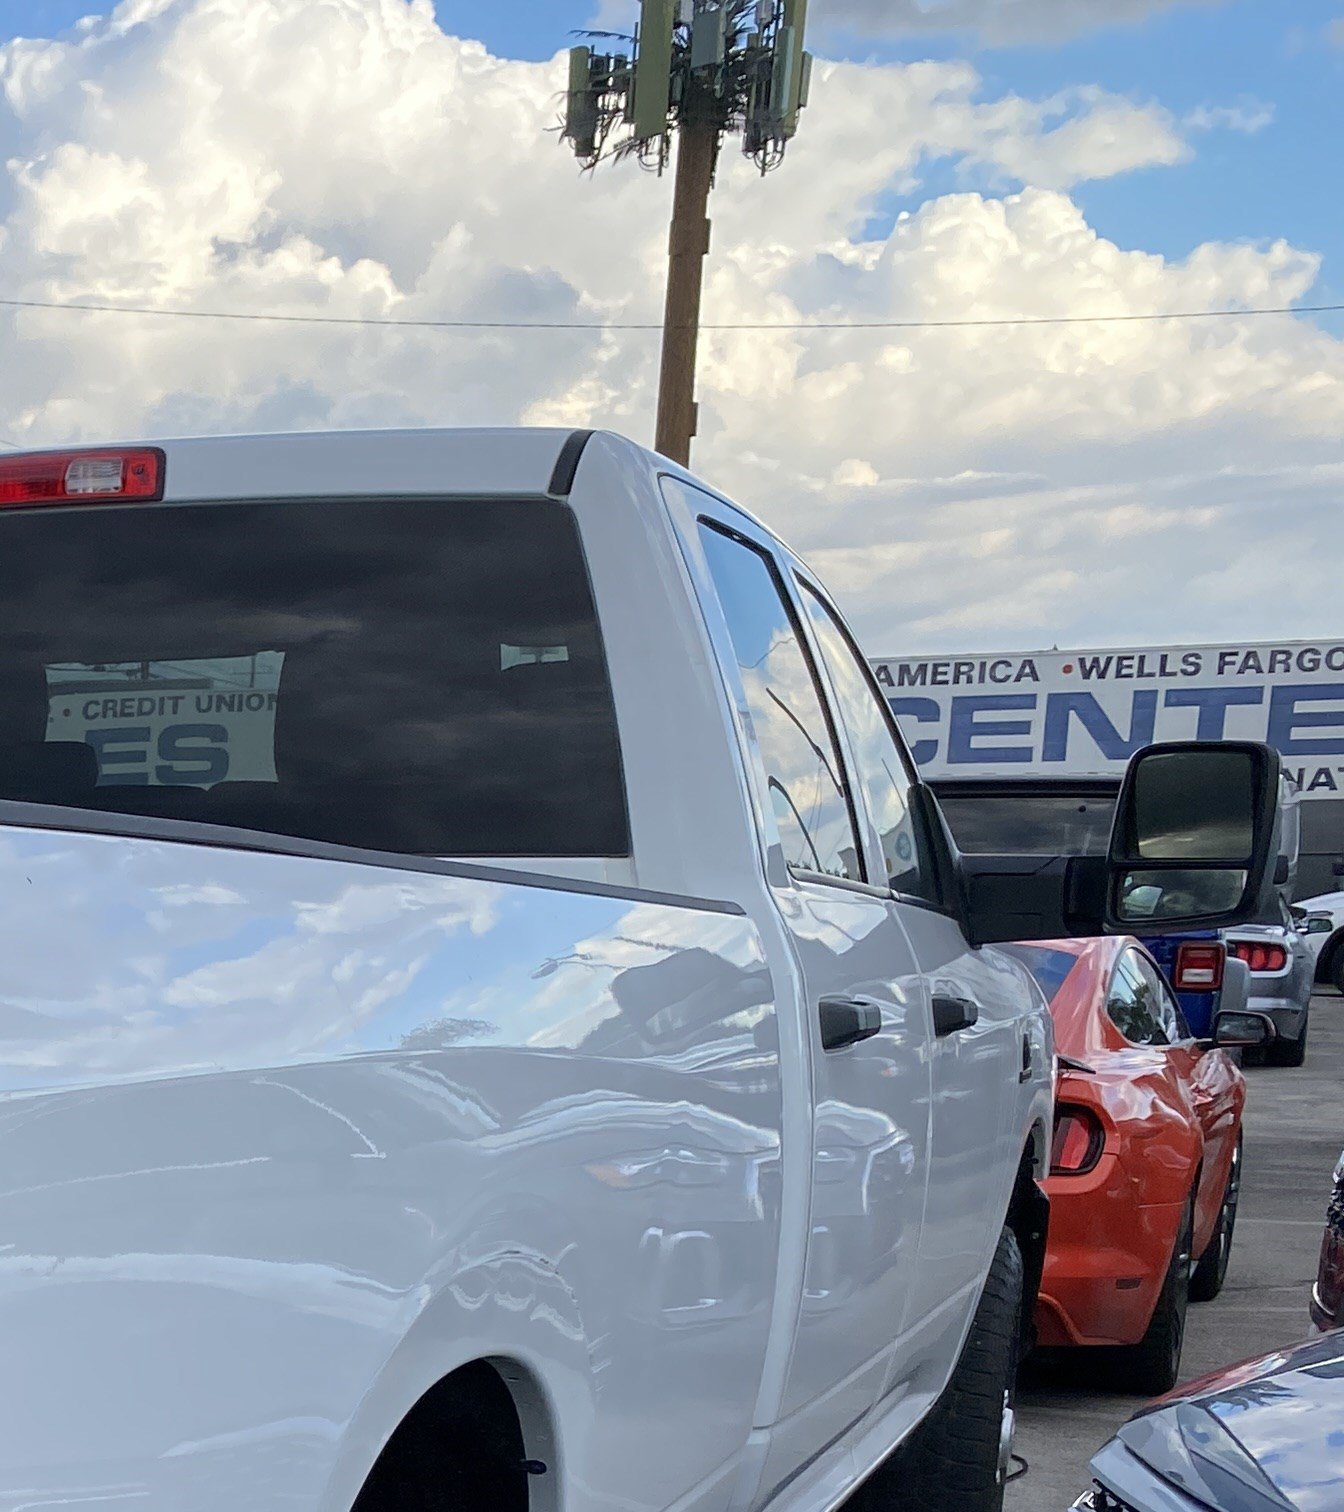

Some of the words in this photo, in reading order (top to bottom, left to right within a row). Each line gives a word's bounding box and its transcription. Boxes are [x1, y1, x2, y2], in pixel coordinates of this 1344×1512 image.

[874, 658, 1040, 688] AMERICA
[1078, 652, 1203, 680] WELLS
[1216, 647, 1344, 676] FARGO
[81, 695, 186, 721] CREDIT
